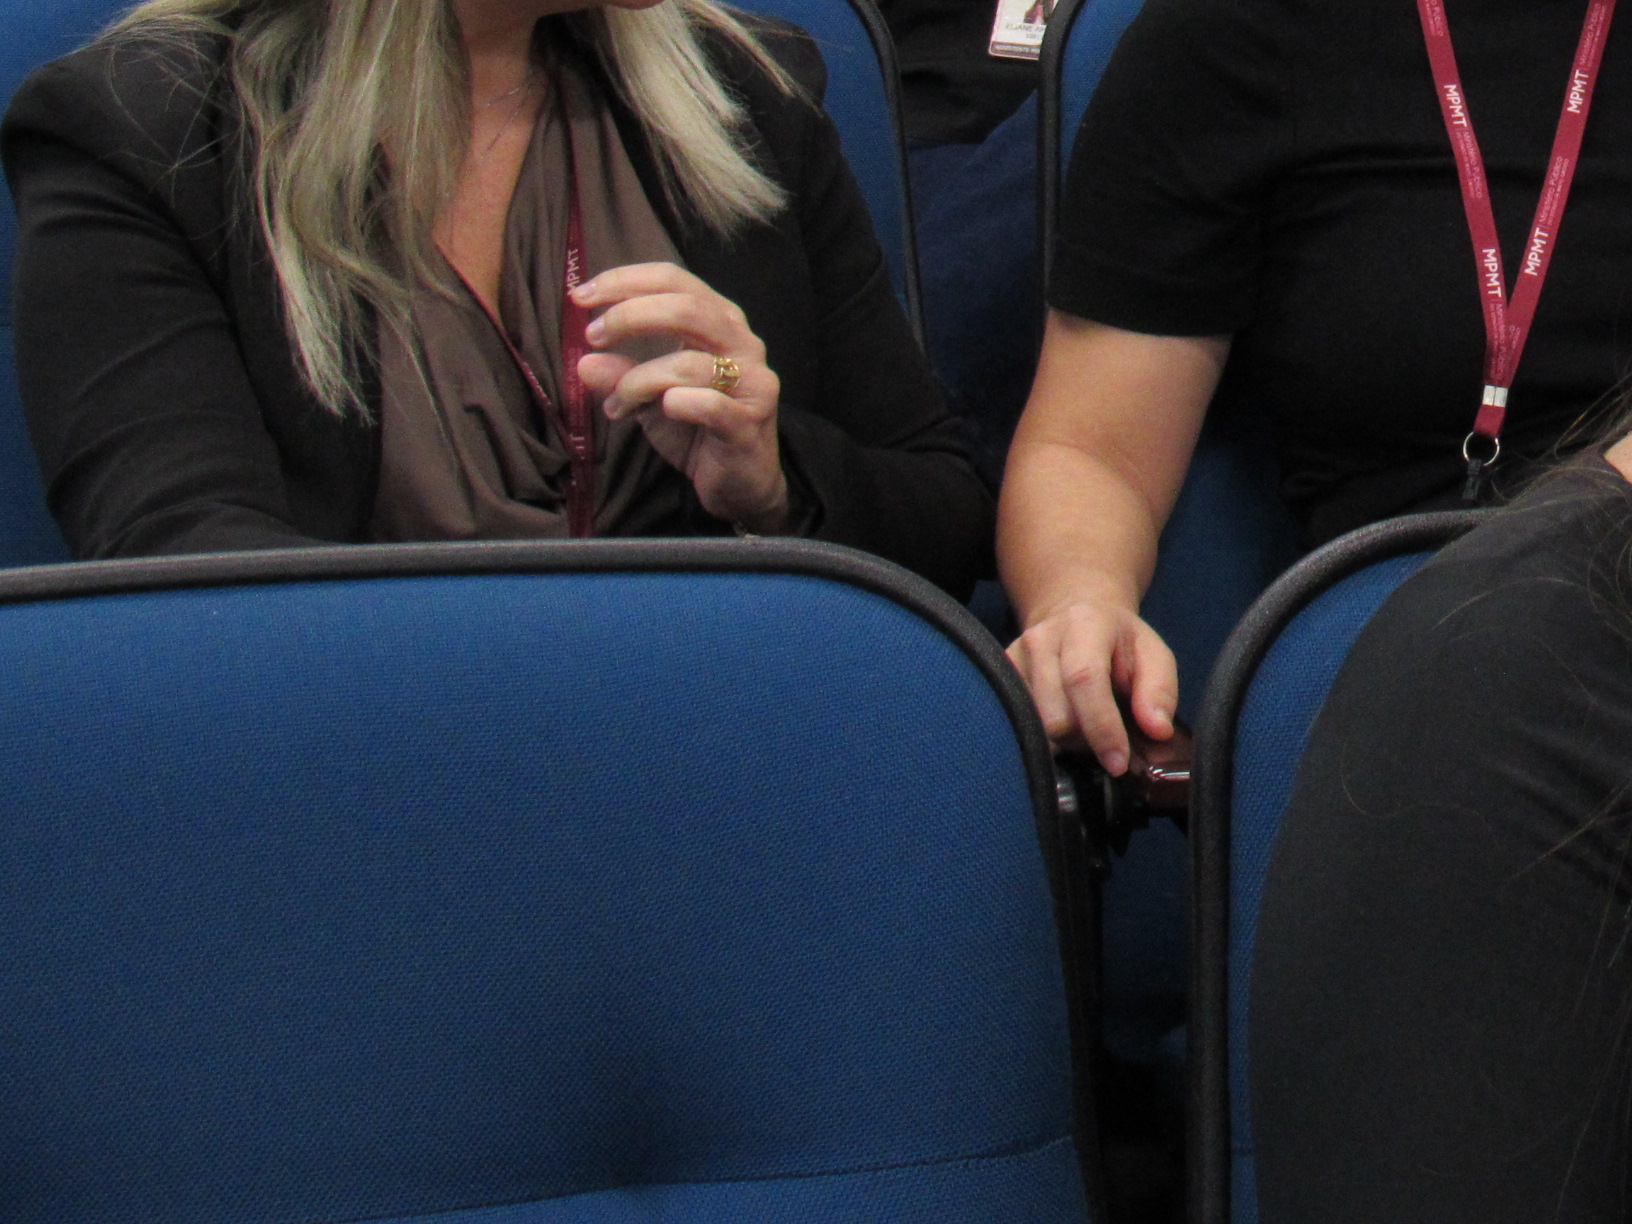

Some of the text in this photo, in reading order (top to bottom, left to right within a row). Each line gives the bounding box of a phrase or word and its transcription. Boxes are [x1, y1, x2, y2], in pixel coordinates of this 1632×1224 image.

[1443, 84, 1468, 128] MPMT
[1567, 69, 1590, 114] MPMT
[1482, 248, 1502, 298] MPMT
[1524, 227, 1549, 276] MPMT
